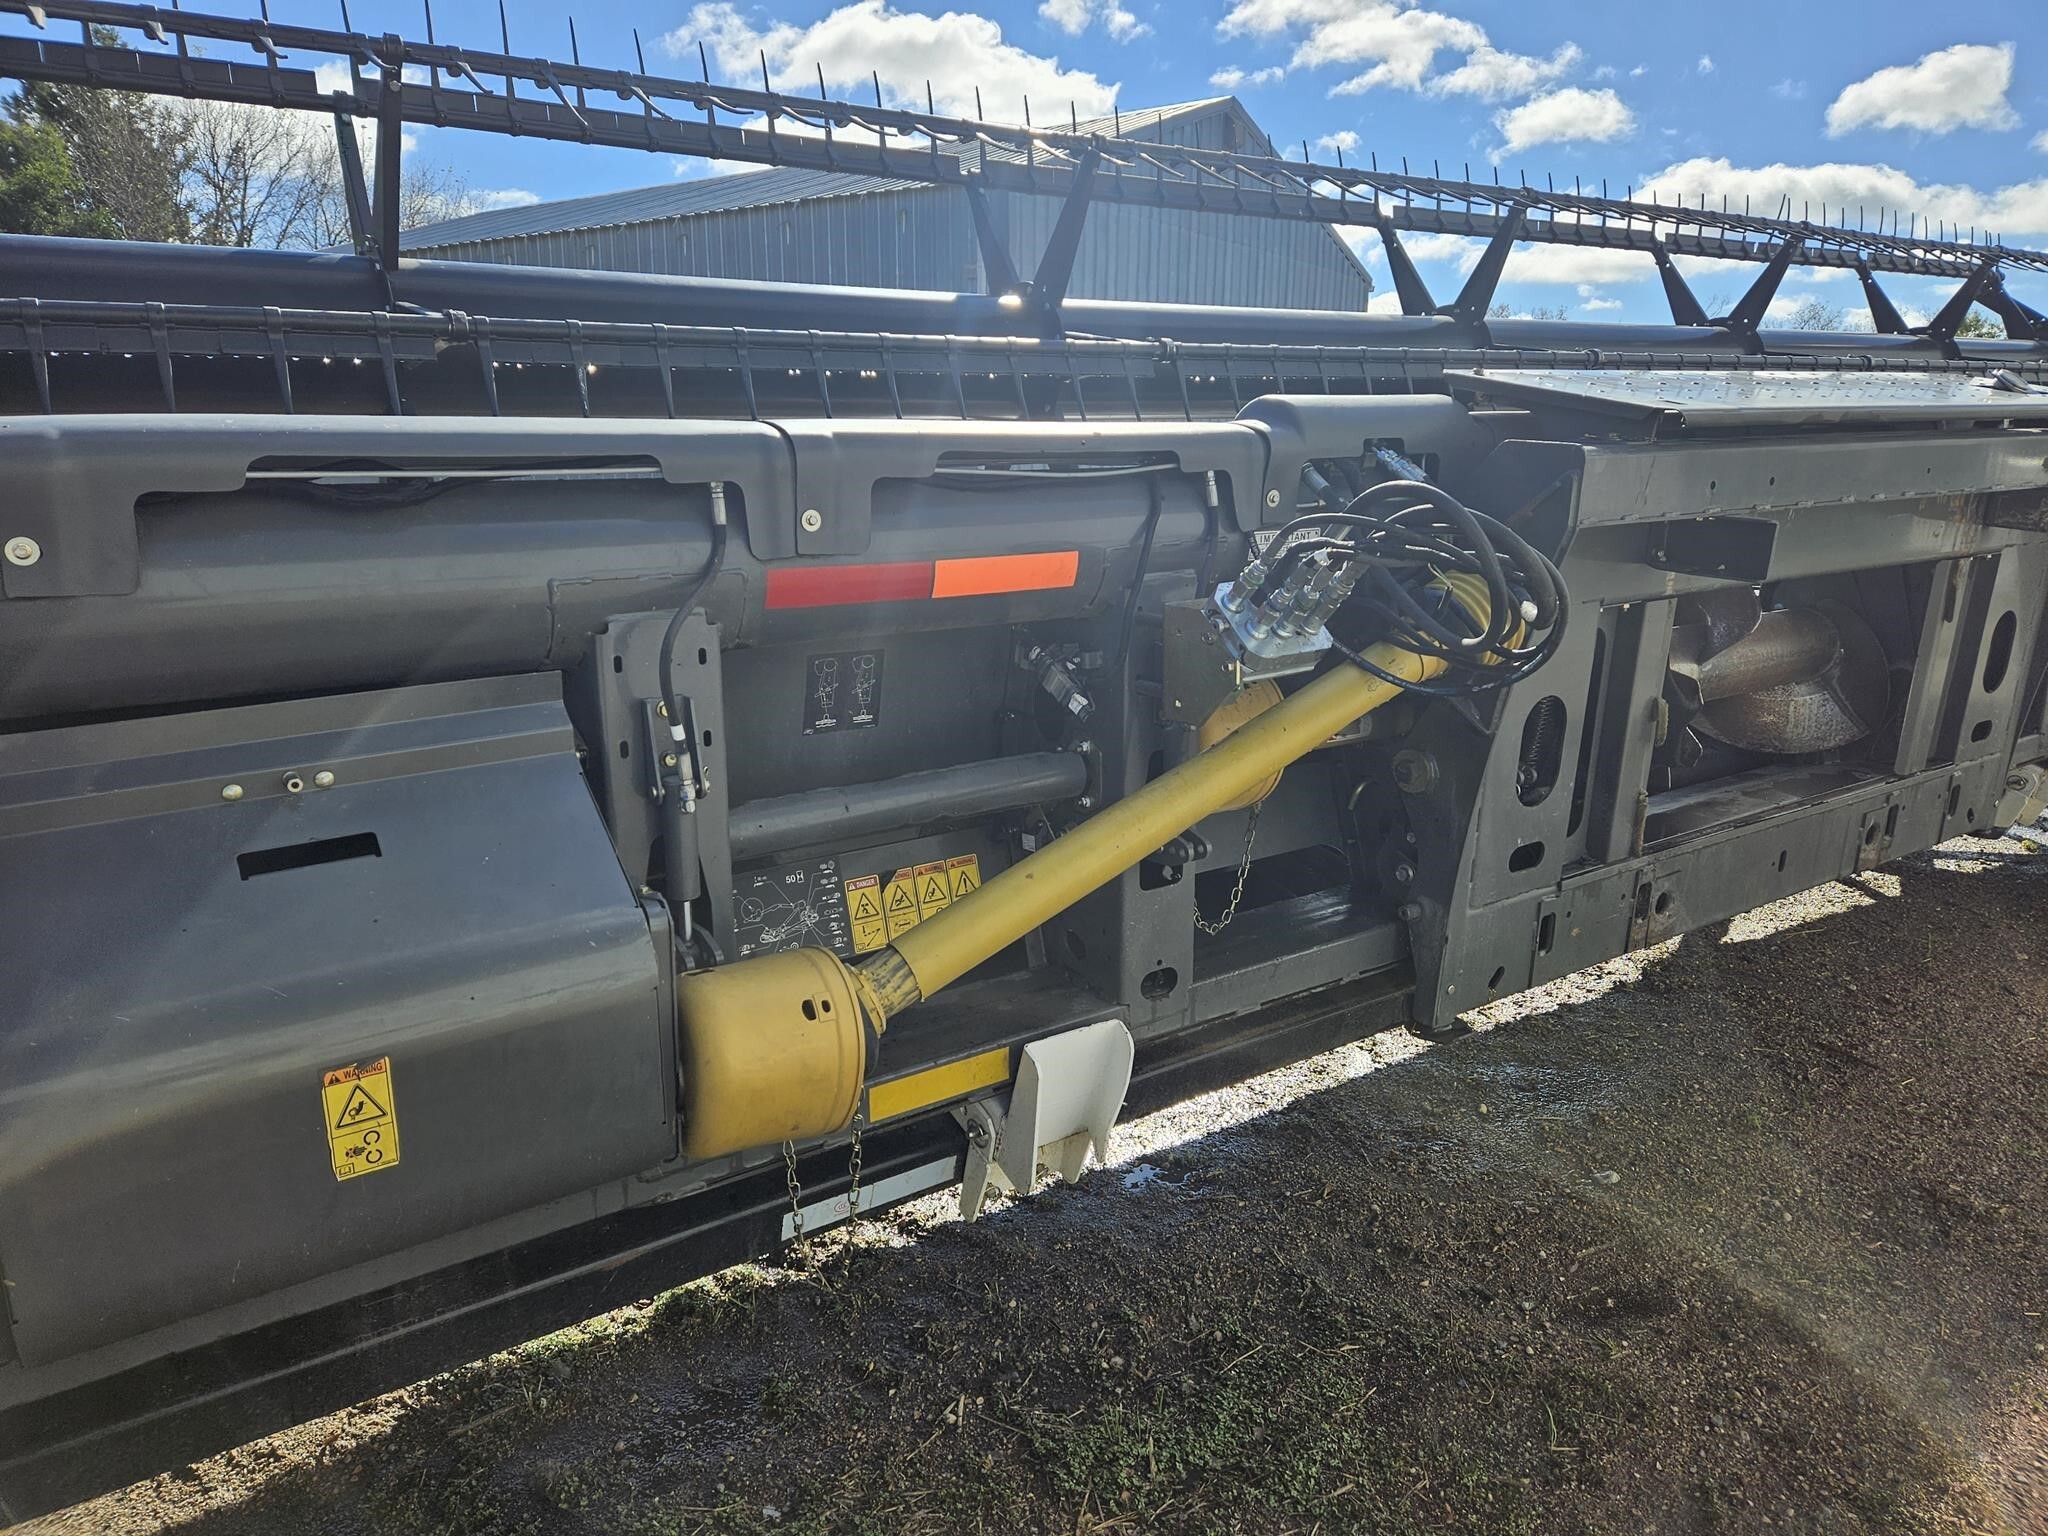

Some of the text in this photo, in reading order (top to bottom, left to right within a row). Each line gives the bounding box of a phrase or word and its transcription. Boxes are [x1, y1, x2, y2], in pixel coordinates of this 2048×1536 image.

[1260, 530, 1311, 542] IMTANT
[785, 875, 796, 884] 50
[856, 878, 875, 888] DANGER
